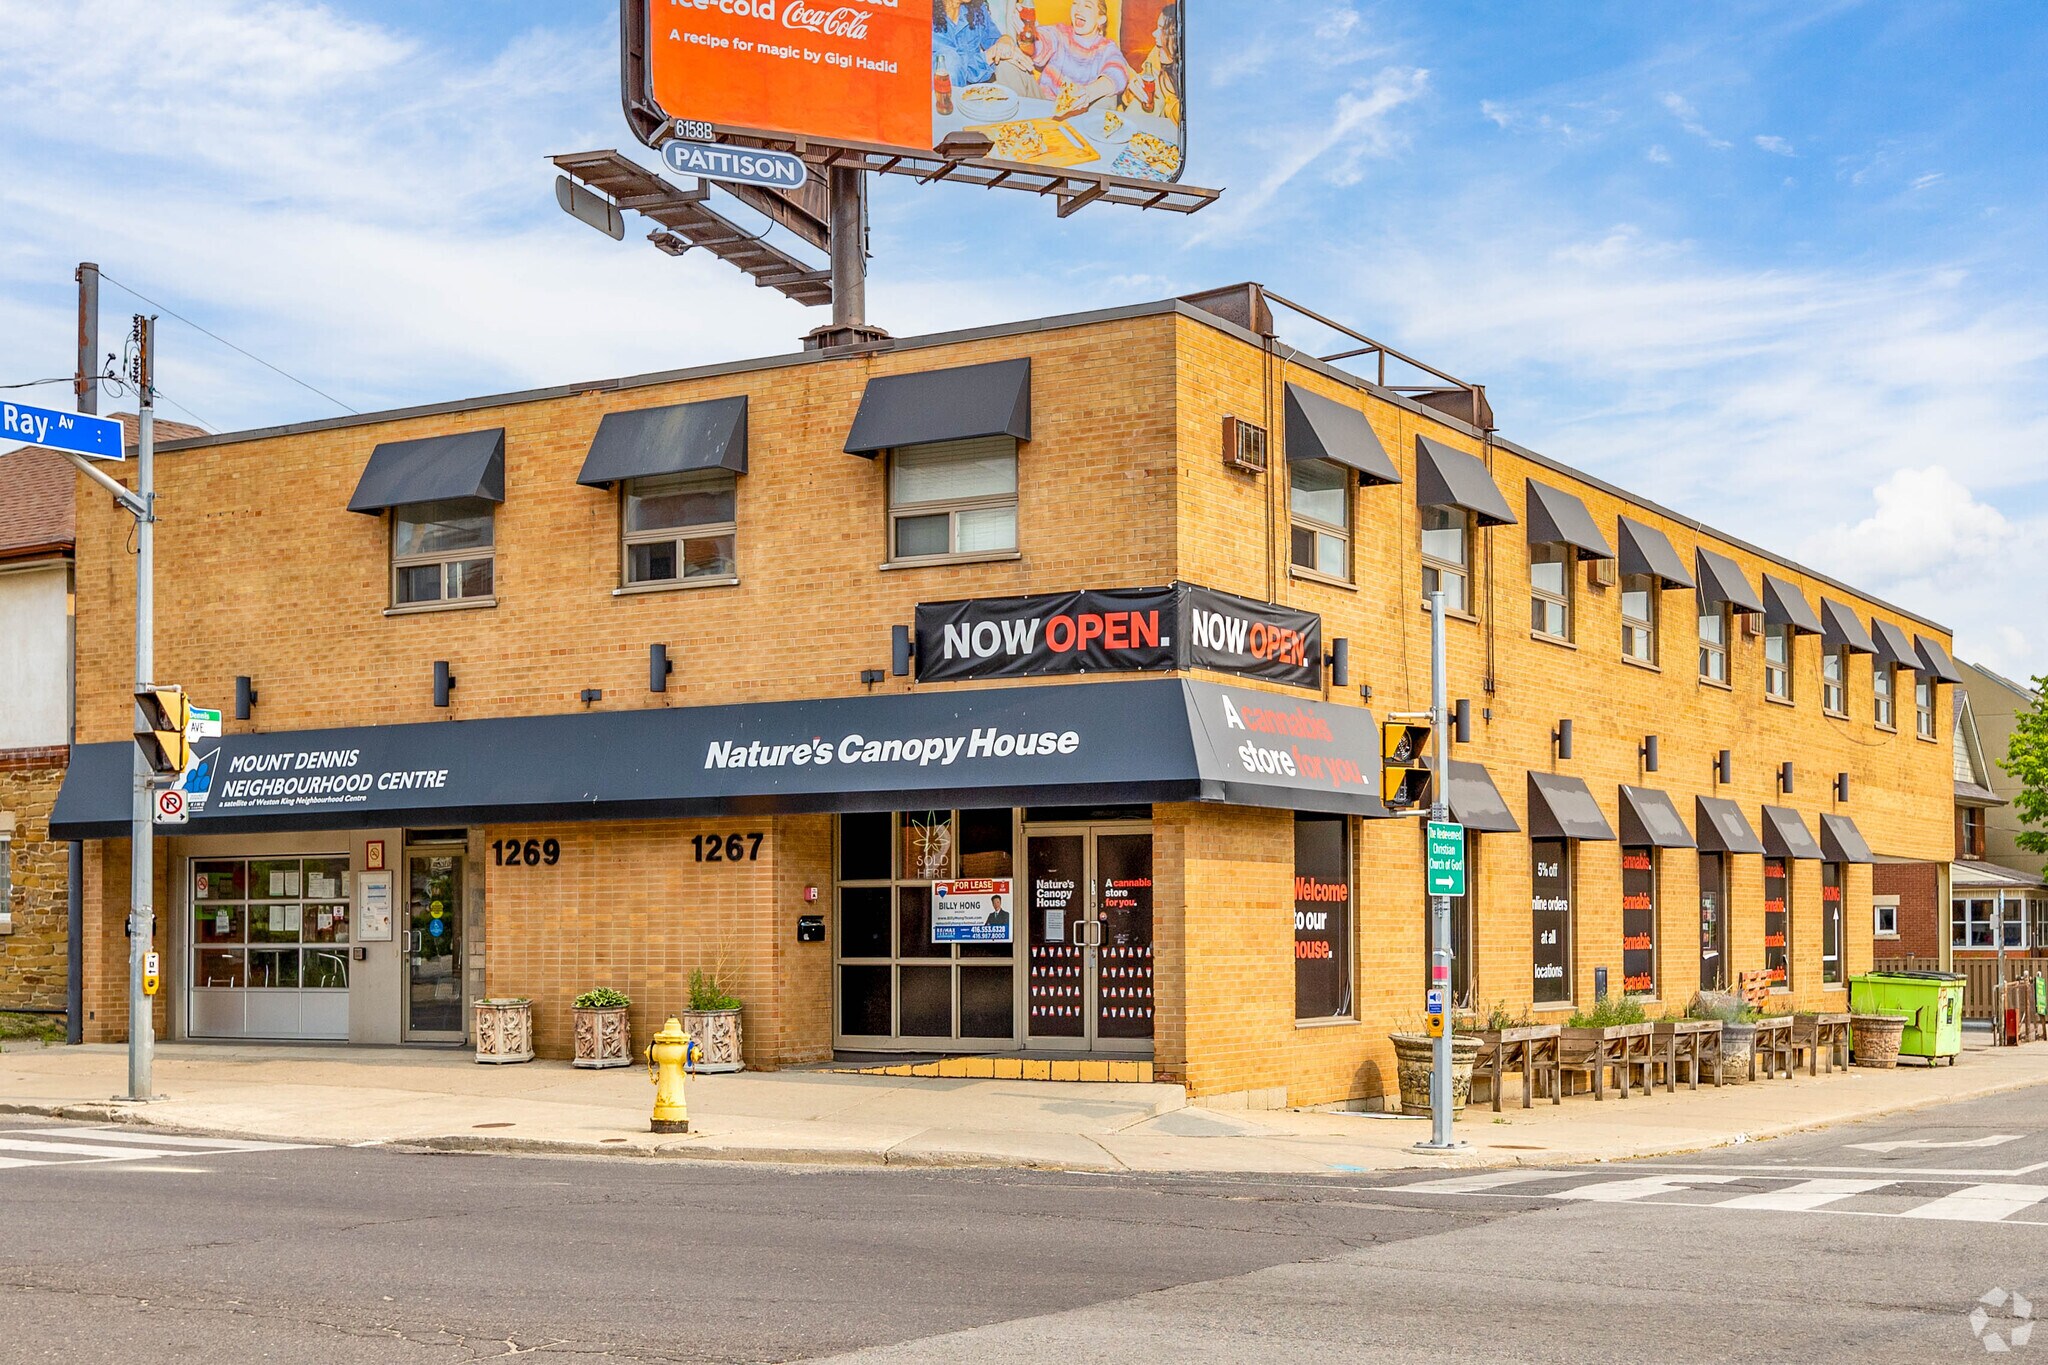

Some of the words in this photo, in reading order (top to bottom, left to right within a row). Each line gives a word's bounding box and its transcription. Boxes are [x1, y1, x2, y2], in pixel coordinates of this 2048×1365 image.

[782, 0, 873, 40] Coca-Cola
[669, 29, 680, 41] A
[683, 33, 729, 49] recipe
[732, 37, 753, 51] for
[757, 42, 801, 60] magic
[803, 49, 821, 64] by
[825, 52, 853, 69] Gigi
[856, 57, 898, 74] Hadid
[676, 120, 713, 139] 6158B
[674, 147, 796, 181] PATTISON
[3, 403, 49, 443] Ray
[58, 414, 74, 430] Av
[944, 618, 1040, 659] NOW
[1045, 610, 1170, 653] OPEN.
[1192, 608, 1248, 656] NOW
[1249, 622, 1309, 668] OPEN.
[1221, 694, 1246, 730] A
[1241, 705, 1334, 743] cannabis
[704, 736, 833, 769] Nature's
[838, 734, 966, 766] Canopy
[966, 727, 1080, 758] House
[229, 753, 294, 773] MOUNT
[294, 749, 360, 770] DENNIS
[1238, 740, 1297, 777] store
[1291, 744, 1325, 780] for
[1323, 756, 1370, 789] you.
[221, 774, 373, 798] NEIGHBOURHOOD
[377, 769, 449, 790] CENTRE
[248, 798, 257, 807] of
[256, 798, 280, 806] Weston
[280, 797, 295, 807] King
[295, 795, 345, 806] Neighbourhood
[344, 794, 367, 802] Centre
[1429, 827, 1437, 839] The
[1436, 827, 1462, 841] Redeemed
[492, 838, 561, 866] 1269
[691, 832, 764, 862] 1267
[1433, 843, 1456, 855] Christian
[916, 855, 949, 866] SOLD
[1430, 858, 1445, 870] Church
[1445, 859, 1451, 870] of
[1451, 859, 1463, 871] God
[1623, 852, 1651, 870] annabis.
[917, 868, 948, 879] HERE
[1537, 862, 1549, 878] 5%
[1548, 863, 1559, 877] off
[955, 881, 969, 890] FOR
[970, 880, 992, 889] LEASE
[1036, 880, 1075, 889] Nature's
[1105, 878, 1113, 888] A
[1113, 878, 1152, 887] cannabis
[1294, 877, 1348, 902] Welcome
[1036, 889, 1073, 899] Canopy
[1105, 889, 1128, 897] store
[1623, 892, 1652, 910] annabis.
[938, 902, 958, 910] BILLY
[959, 901, 981, 910] HONG
[1036, 898, 1067, 907] House
[1105, 898, 1118, 907] for
[1119, 899, 1138, 908] you.
[1532, 895, 1548, 911] nline
[1547, 896, 1568, 911] orders
[1305, 911, 1328, 930] our
[1540, 930, 1548, 944] at
[1548, 929, 1557, 944] all
[1623, 932, 1652, 950] annabis.
[1294, 941, 1333, 959] ouse.
[1534, 963, 1563, 979] locations
[1623, 971, 1653, 990] annabis.
